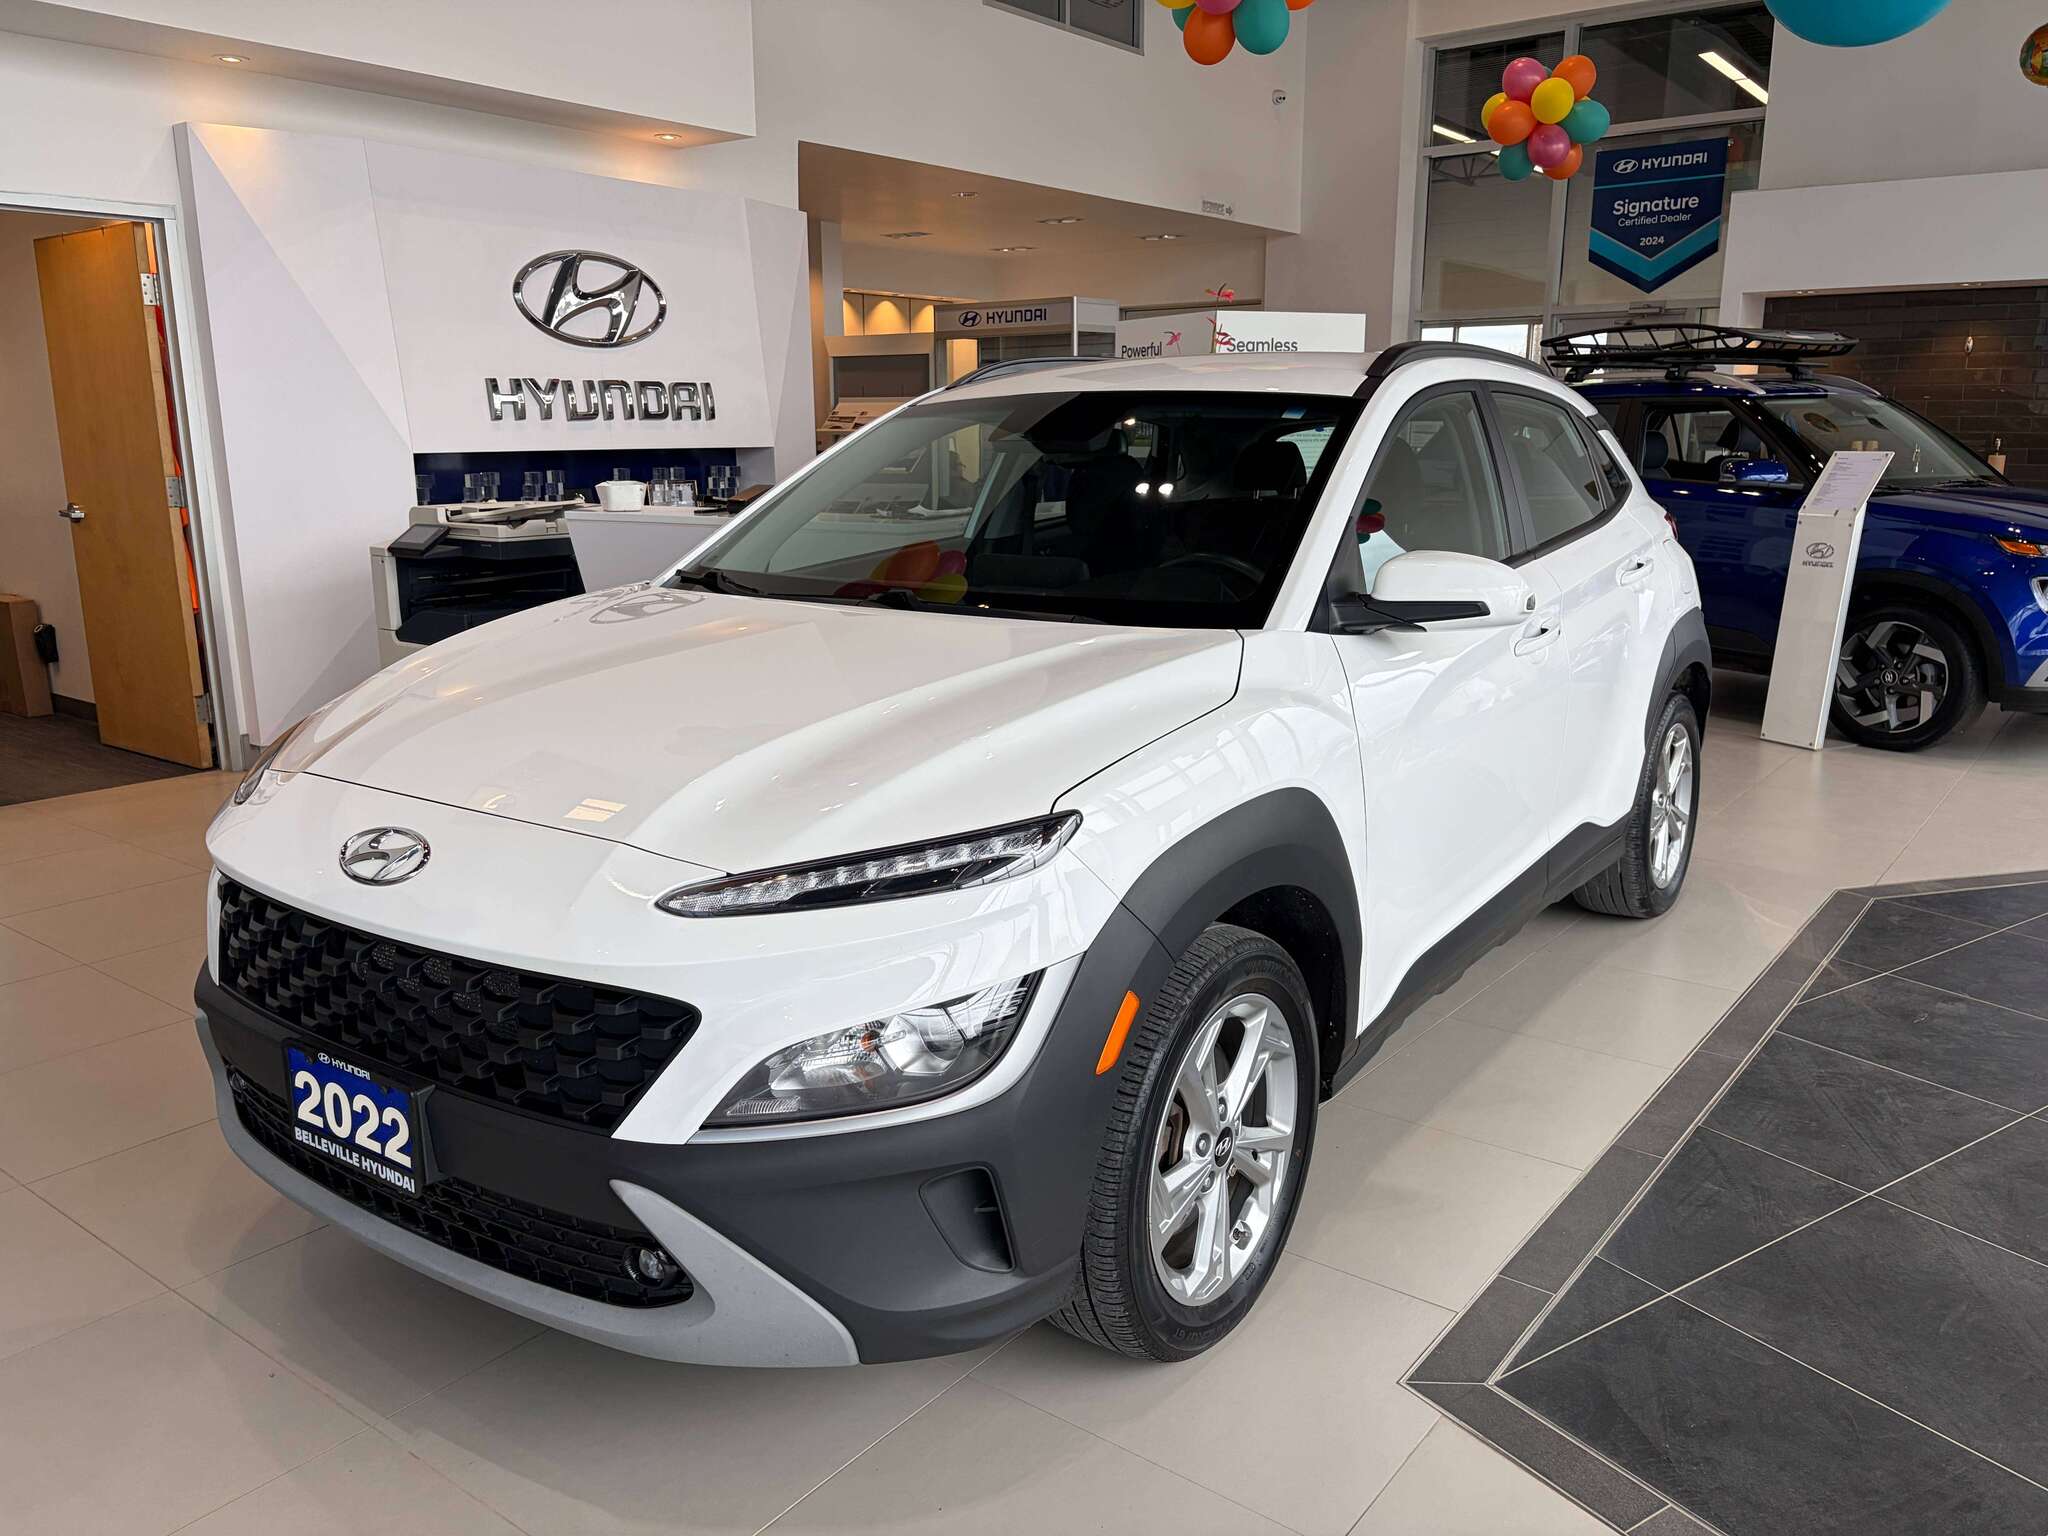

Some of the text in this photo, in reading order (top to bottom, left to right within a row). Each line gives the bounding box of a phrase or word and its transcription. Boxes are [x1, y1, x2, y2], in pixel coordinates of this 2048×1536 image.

[1641, 152, 1707, 169] HYUNDAI
[1613, 196, 1699, 216] Signature
[1618, 213, 1692, 226] Certified Dealer
[1639, 236, 1664, 246] 2024
[986, 308, 1047, 324] HYUNDAI
[1121, 341, 1162, 359] Powerful
[1226, 337, 1299, 352] Seamless
[484, 377, 716, 422] HYUNDAI
[1802, 560, 1833, 569] HYUN
[331, 1058, 370, 1080] HYUNDAI
[294, 1070, 412, 1169] 2022
[294, 1126, 416, 1194] BELLEVILLE HYUNDAI
